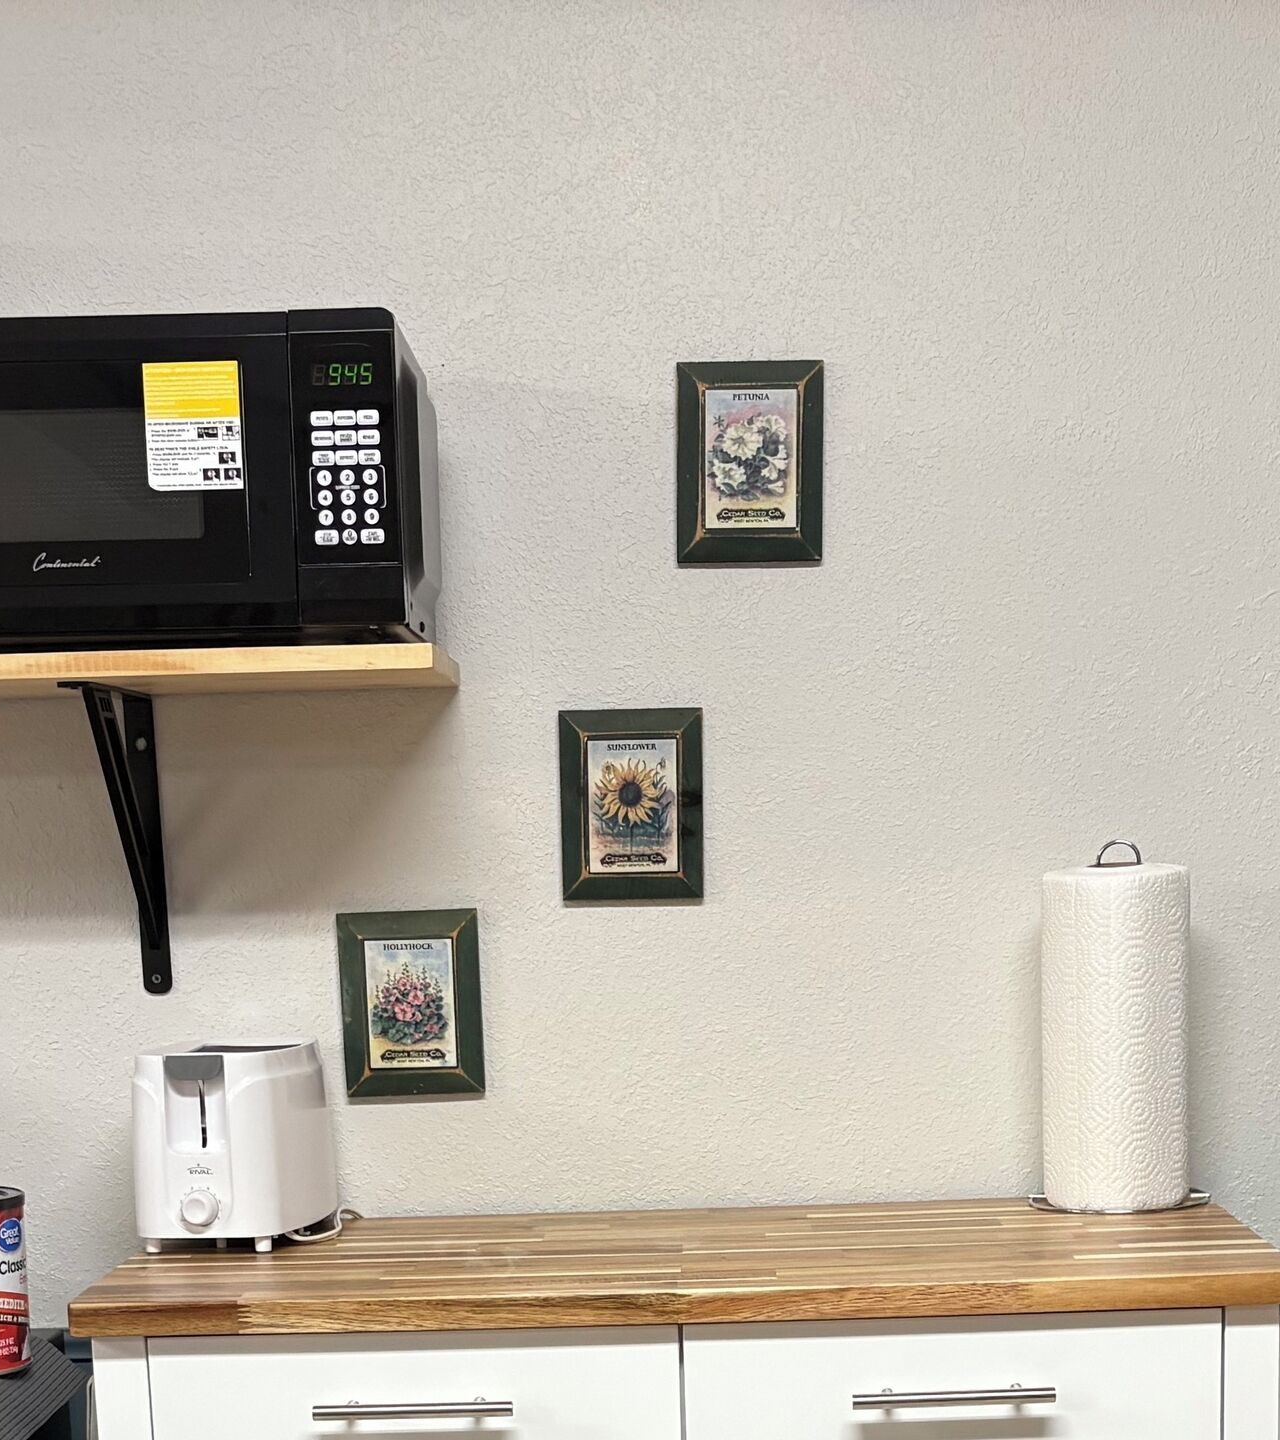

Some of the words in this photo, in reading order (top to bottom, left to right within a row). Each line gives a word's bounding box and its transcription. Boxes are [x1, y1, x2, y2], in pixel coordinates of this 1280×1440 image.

[732, 393, 770, 401] PETUNIA
[607, 743, 657, 751] SUNFLOWER
[383, 943, 434, 951] HOLLYHOCK
